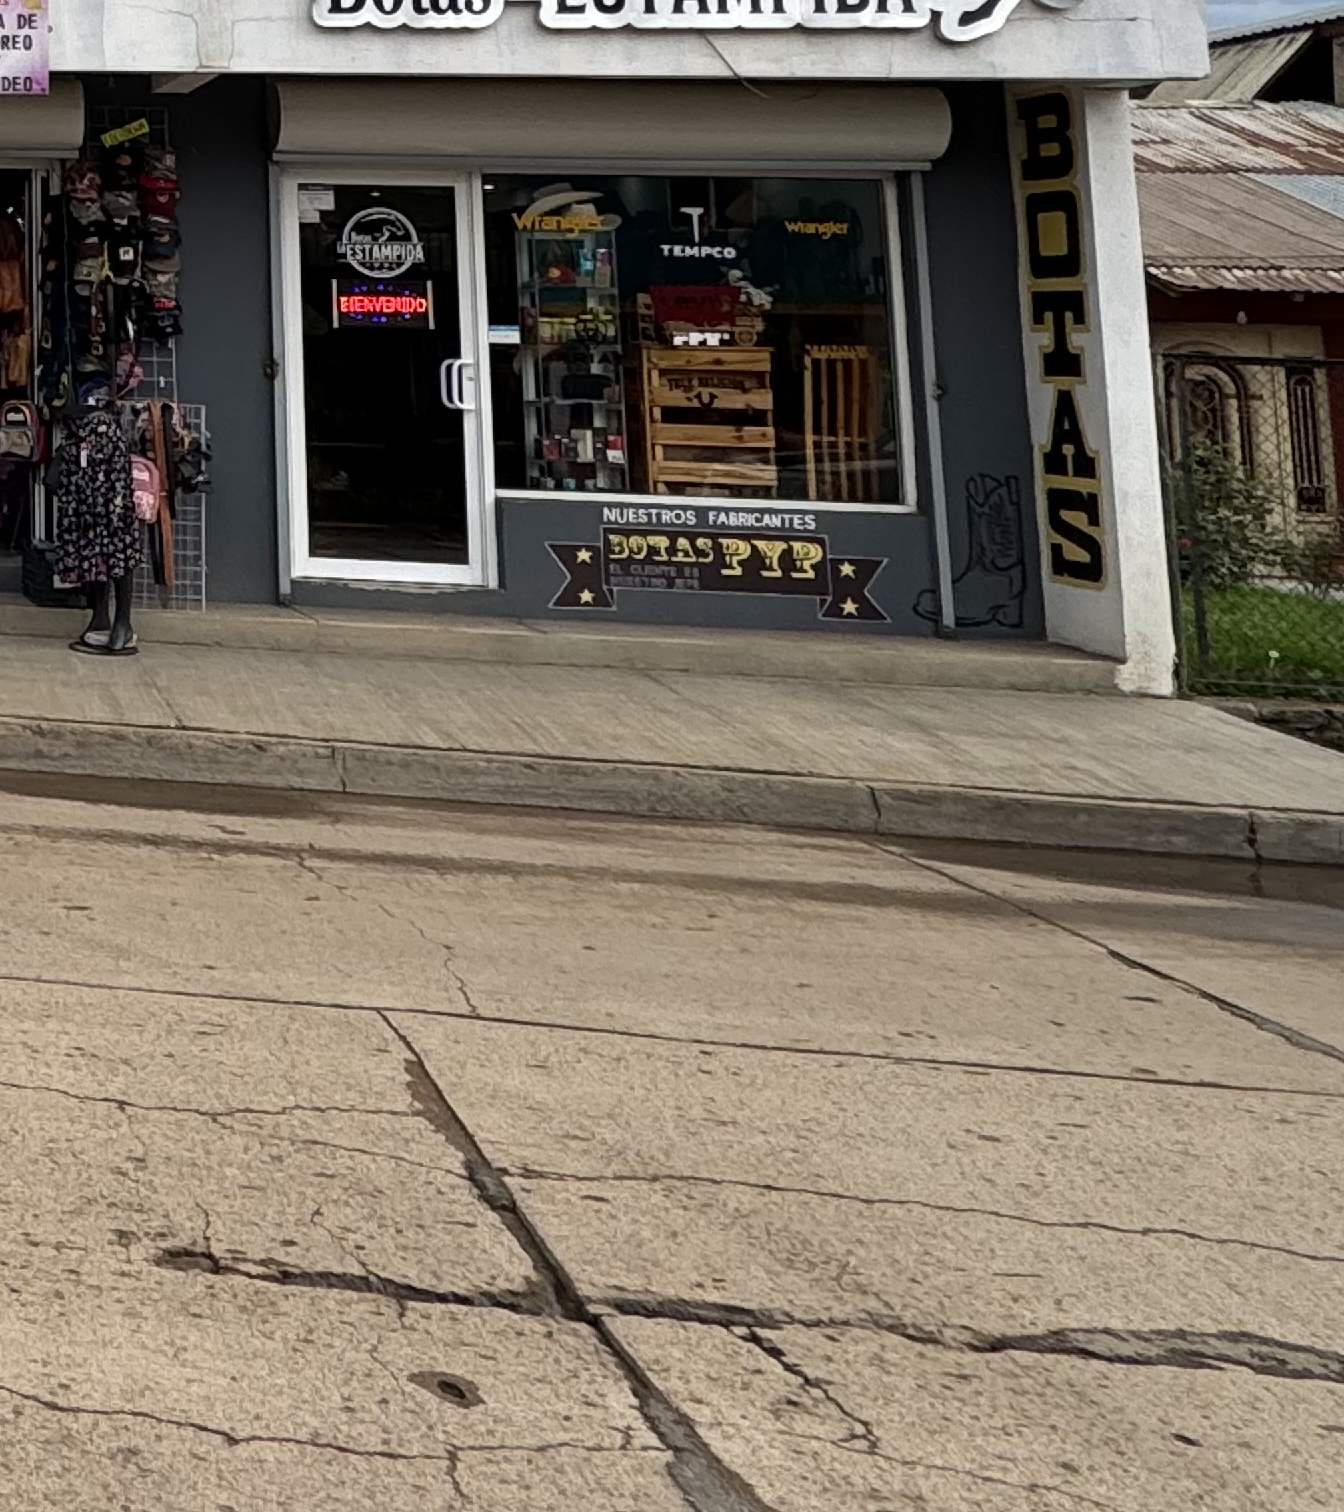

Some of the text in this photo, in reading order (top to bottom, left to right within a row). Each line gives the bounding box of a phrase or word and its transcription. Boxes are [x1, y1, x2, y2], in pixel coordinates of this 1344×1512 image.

[16, 13, 39, 30] DE
[784, 220, 850, 239] Wrangler
[346, 242, 426, 263] ESTAMPIDA
[660, 244, 737, 259] TEMPCO
[1016, 92, 1103, 582] BOTAS
[602, 507, 816, 529] NUESTROS FABRICANTES
[608, 534, 824, 580] BOTAS PYP
